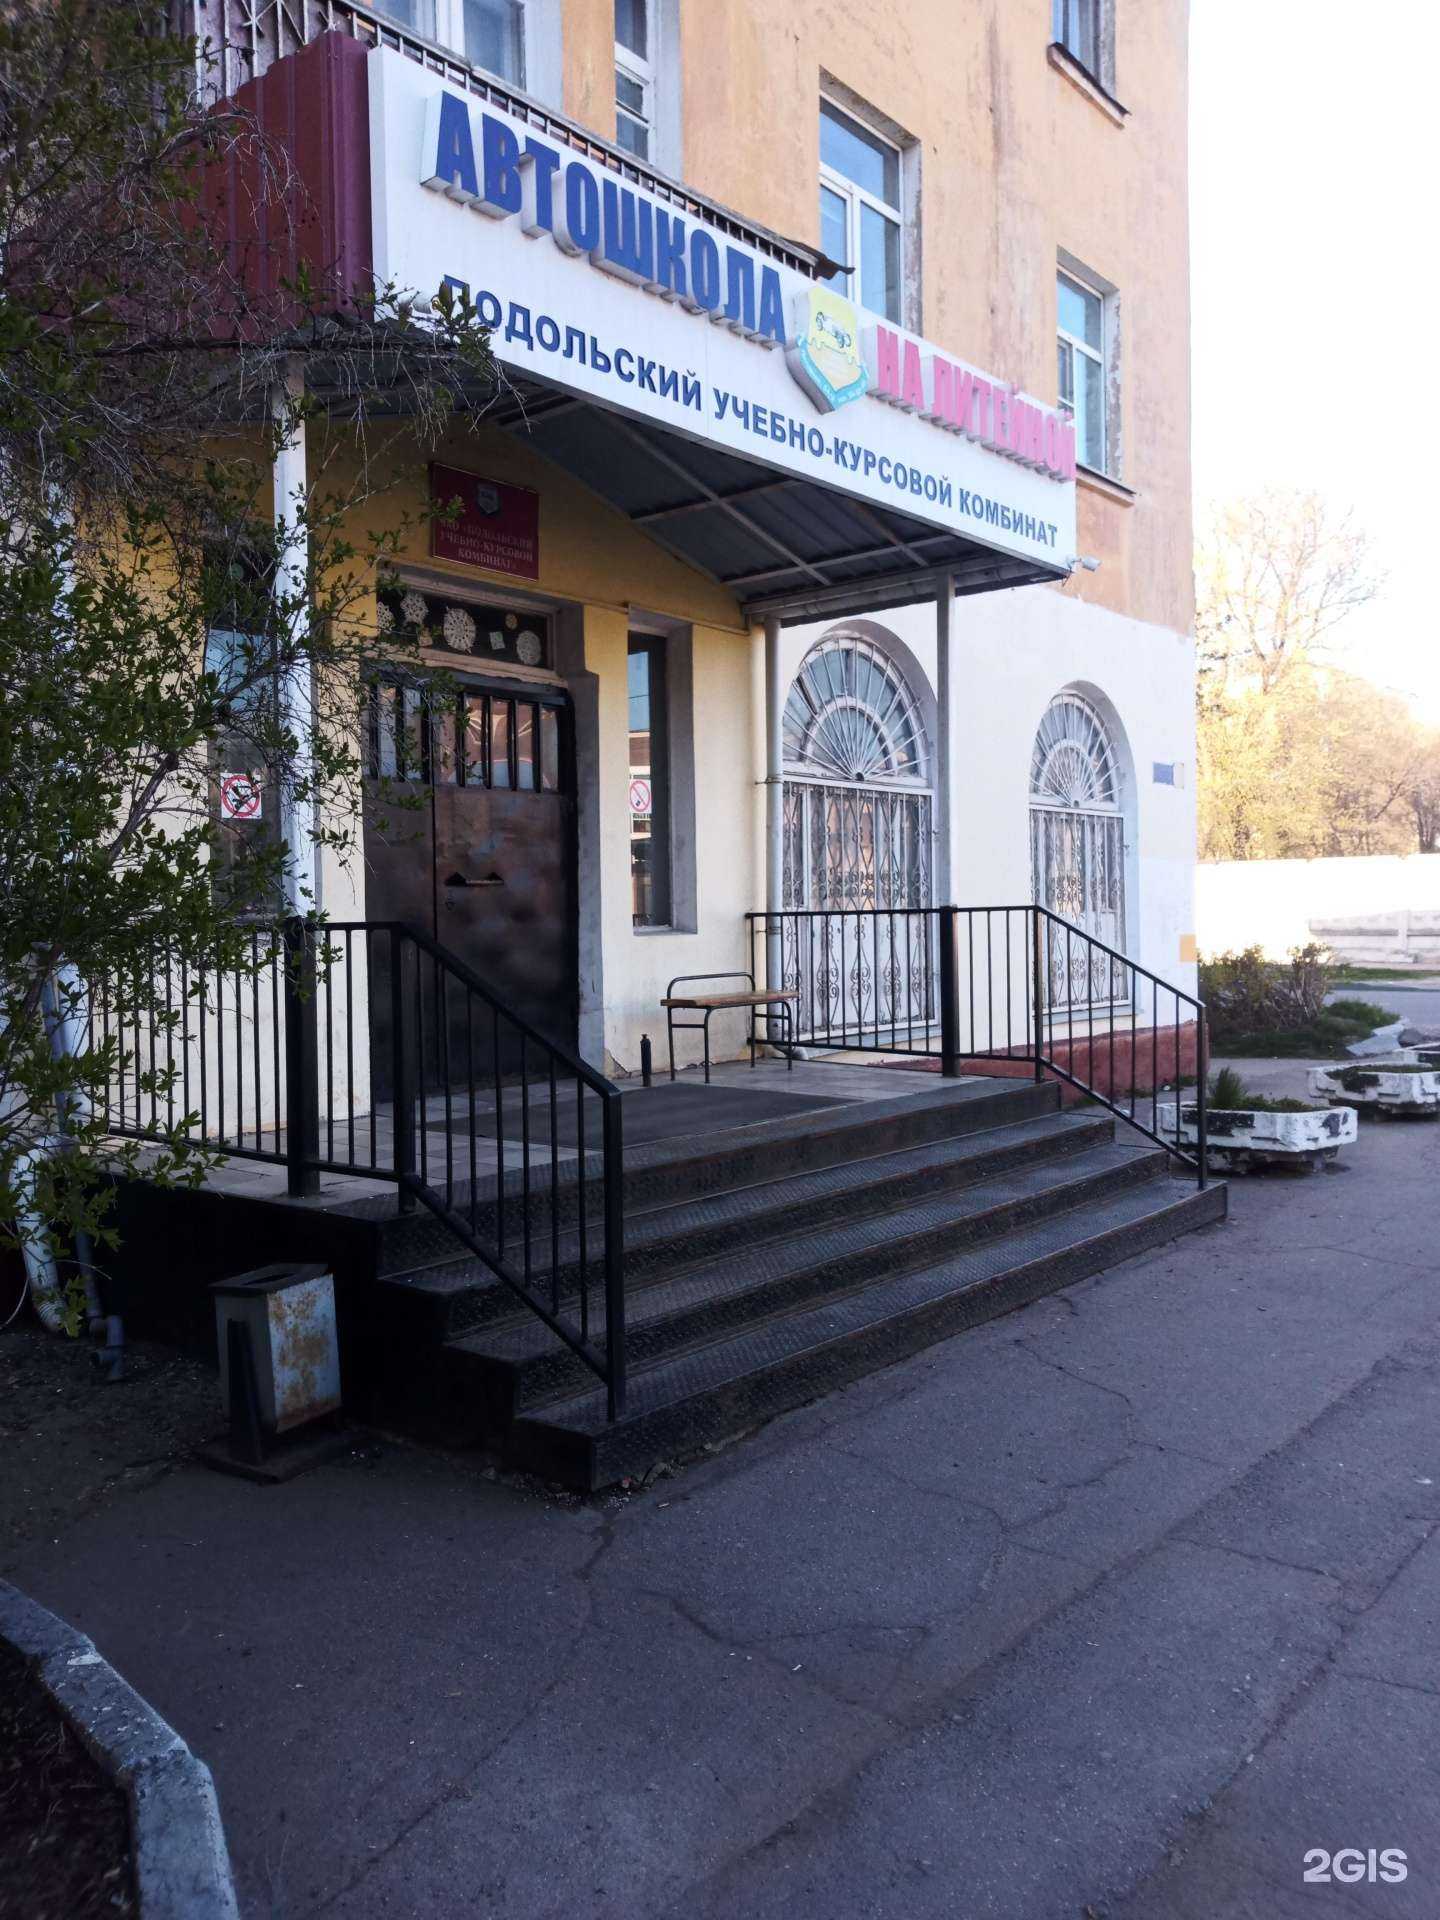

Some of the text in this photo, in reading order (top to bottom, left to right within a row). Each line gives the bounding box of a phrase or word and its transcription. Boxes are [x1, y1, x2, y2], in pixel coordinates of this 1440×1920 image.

[436, 89, 787, 346] АВТОШКОЛА
[876, 323, 925, 411] НА
[712, 387, 953, 508] УЧЕБНО-КУРСОВОЙ
[959, 487, 1059, 548] КОМБИНАТ
